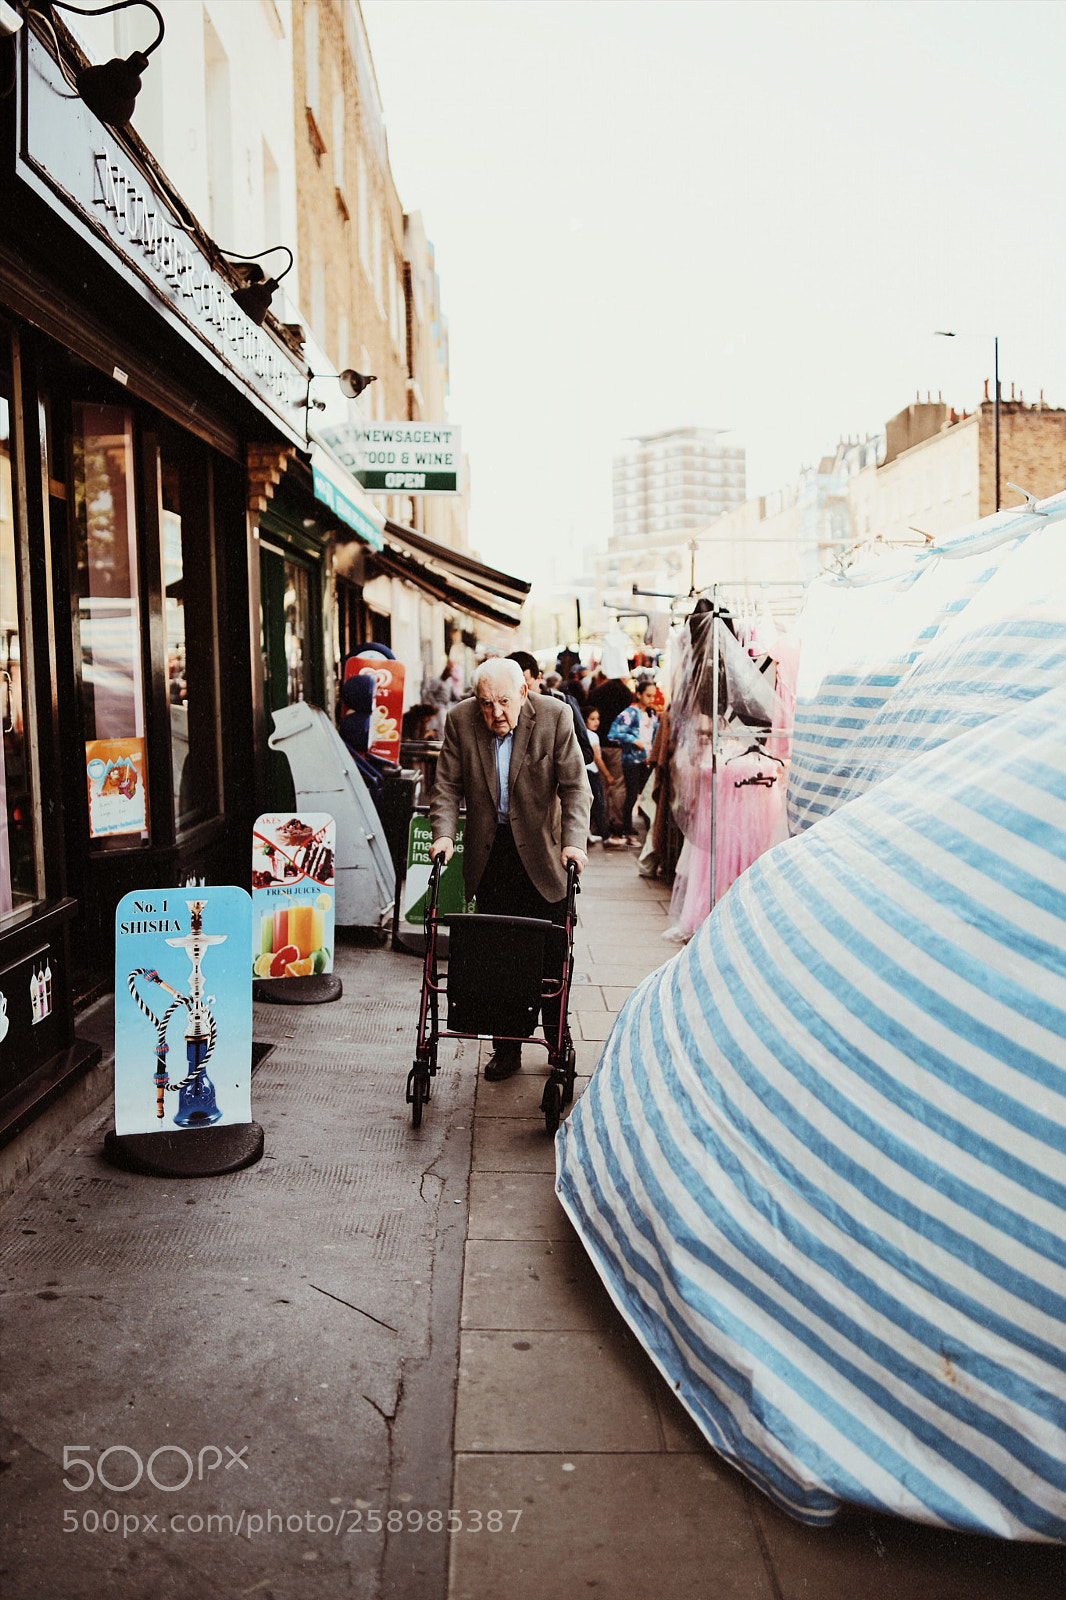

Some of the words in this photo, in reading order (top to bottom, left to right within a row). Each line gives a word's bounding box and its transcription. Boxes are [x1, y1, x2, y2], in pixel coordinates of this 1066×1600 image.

[362, 429, 453, 444] NEWSAGENT
[401, 452, 409, 464] &
[415, 452, 453, 465] WINE
[385, 472, 426, 488] OPEN
[266, 886, 292, 896] FRESH
[294, 887, 321, 896] JUICES
[133, 900, 157, 914] No.
[162, 900, 168, 912] 1
[120, 919, 181, 935] SHISHA
